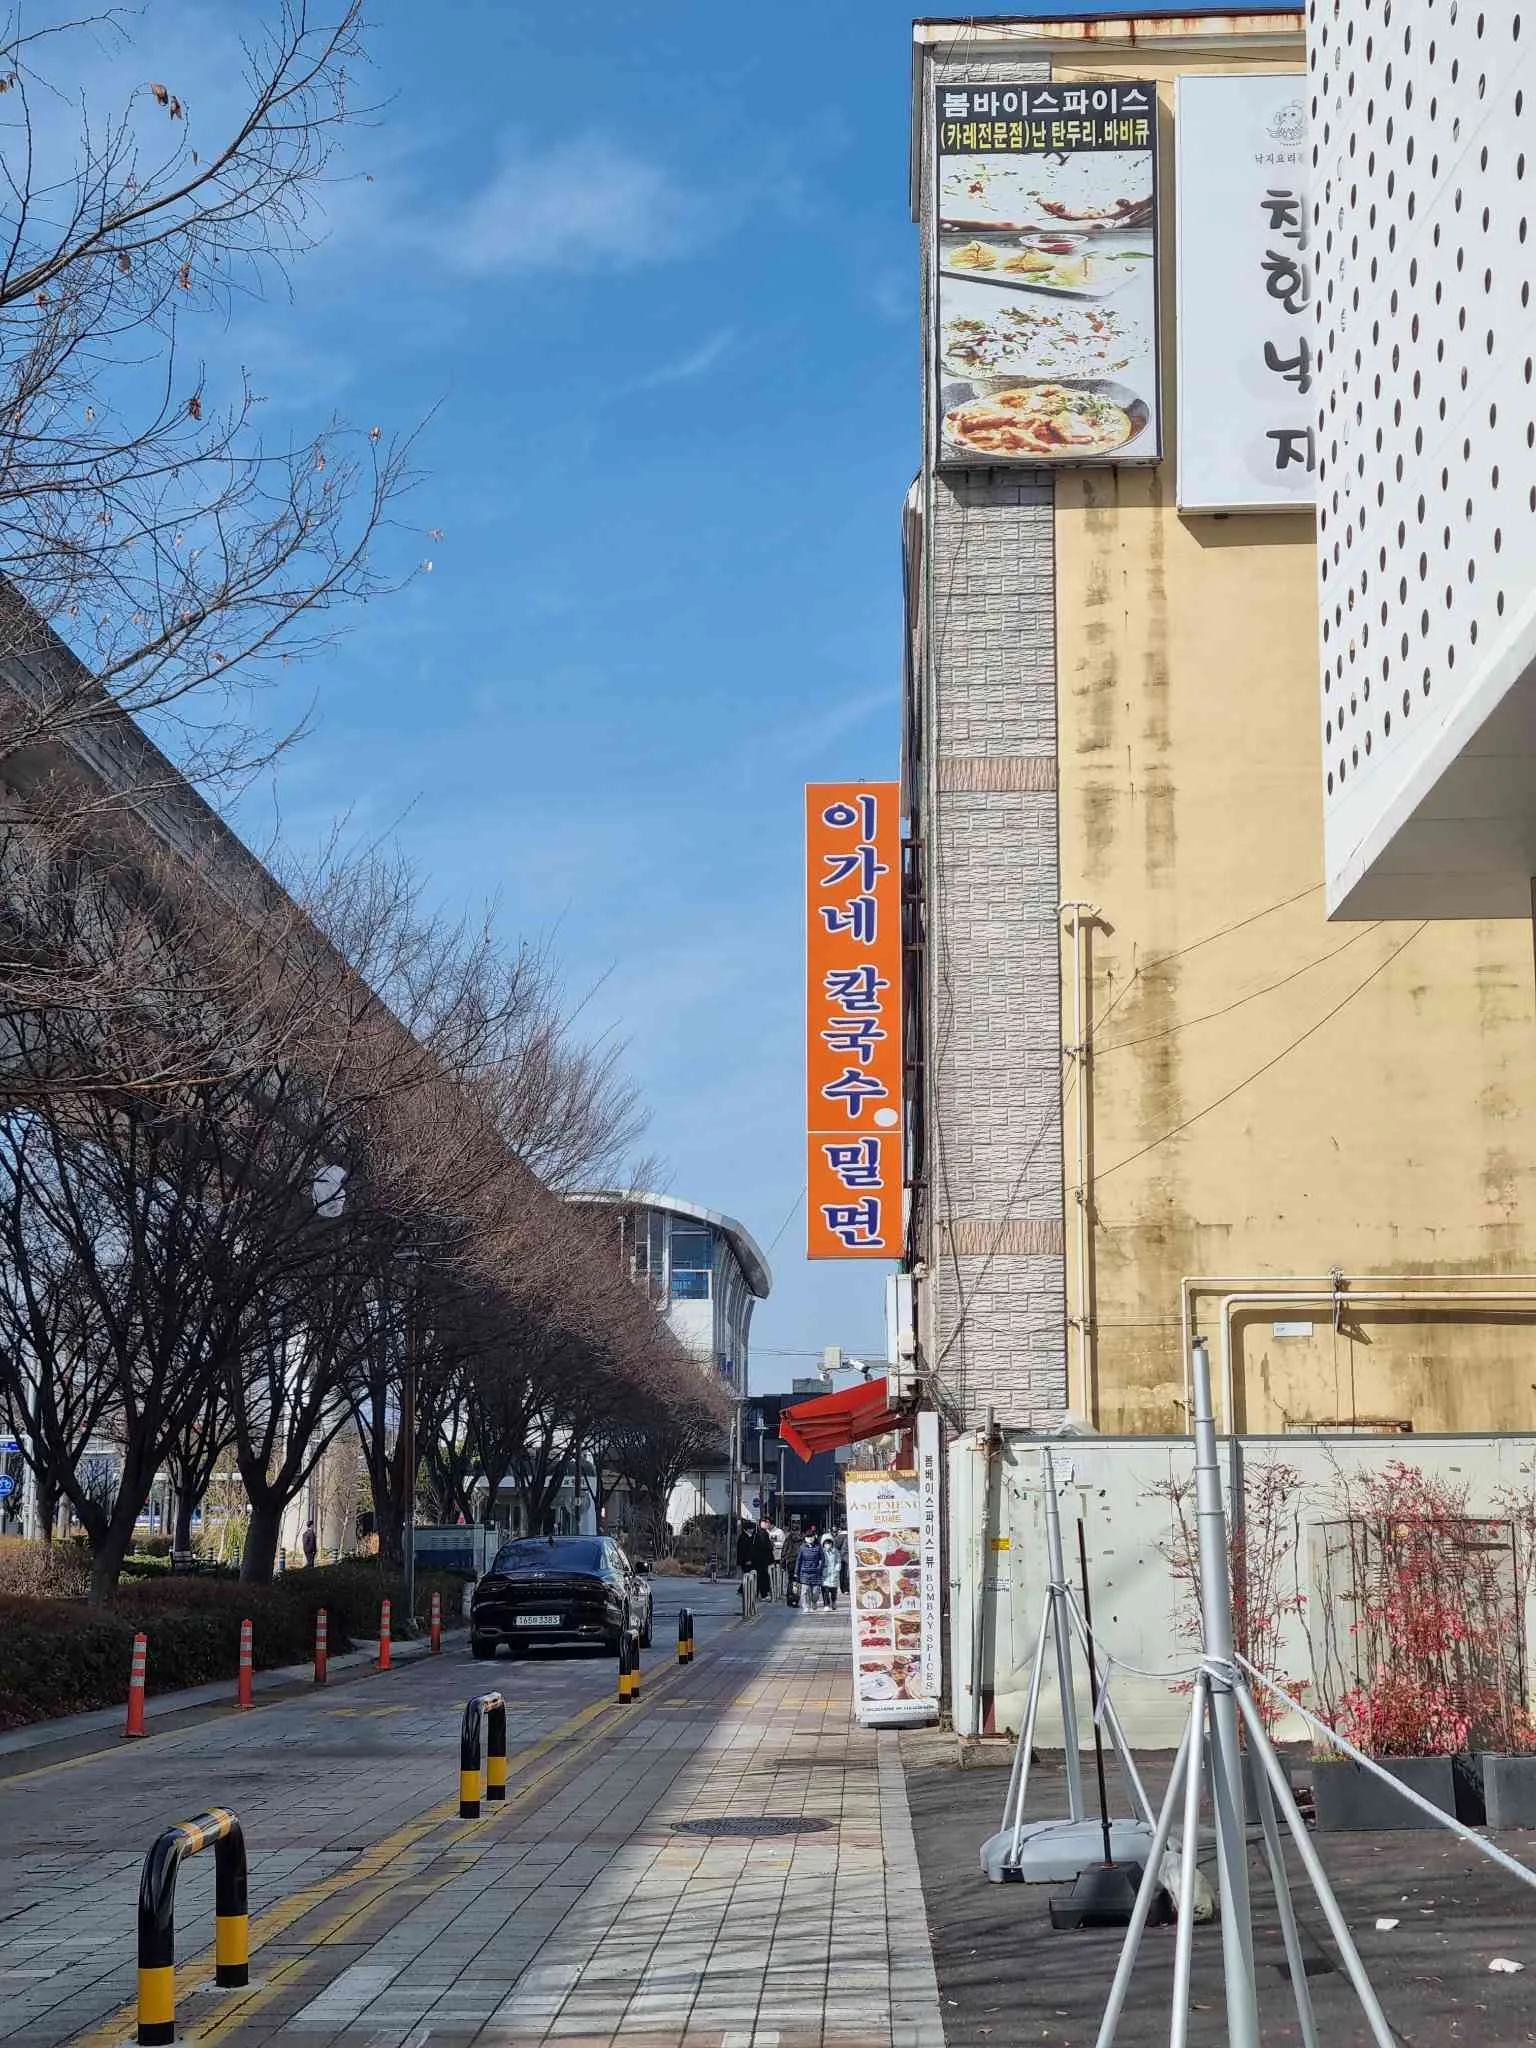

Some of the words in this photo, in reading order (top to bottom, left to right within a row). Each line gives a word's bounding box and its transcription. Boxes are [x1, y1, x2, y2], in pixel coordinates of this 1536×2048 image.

[943, 88, 1149, 117] 봄바이스파이스
[820, 794, 888, 945] 이가네
[821, 966, 889, 1119] 칼국수
[822, 1137, 887, 1249] 밀면
[925, 1574, 935, 1629] BOMBAY
[925, 1633, 935, 1690] SPICES
